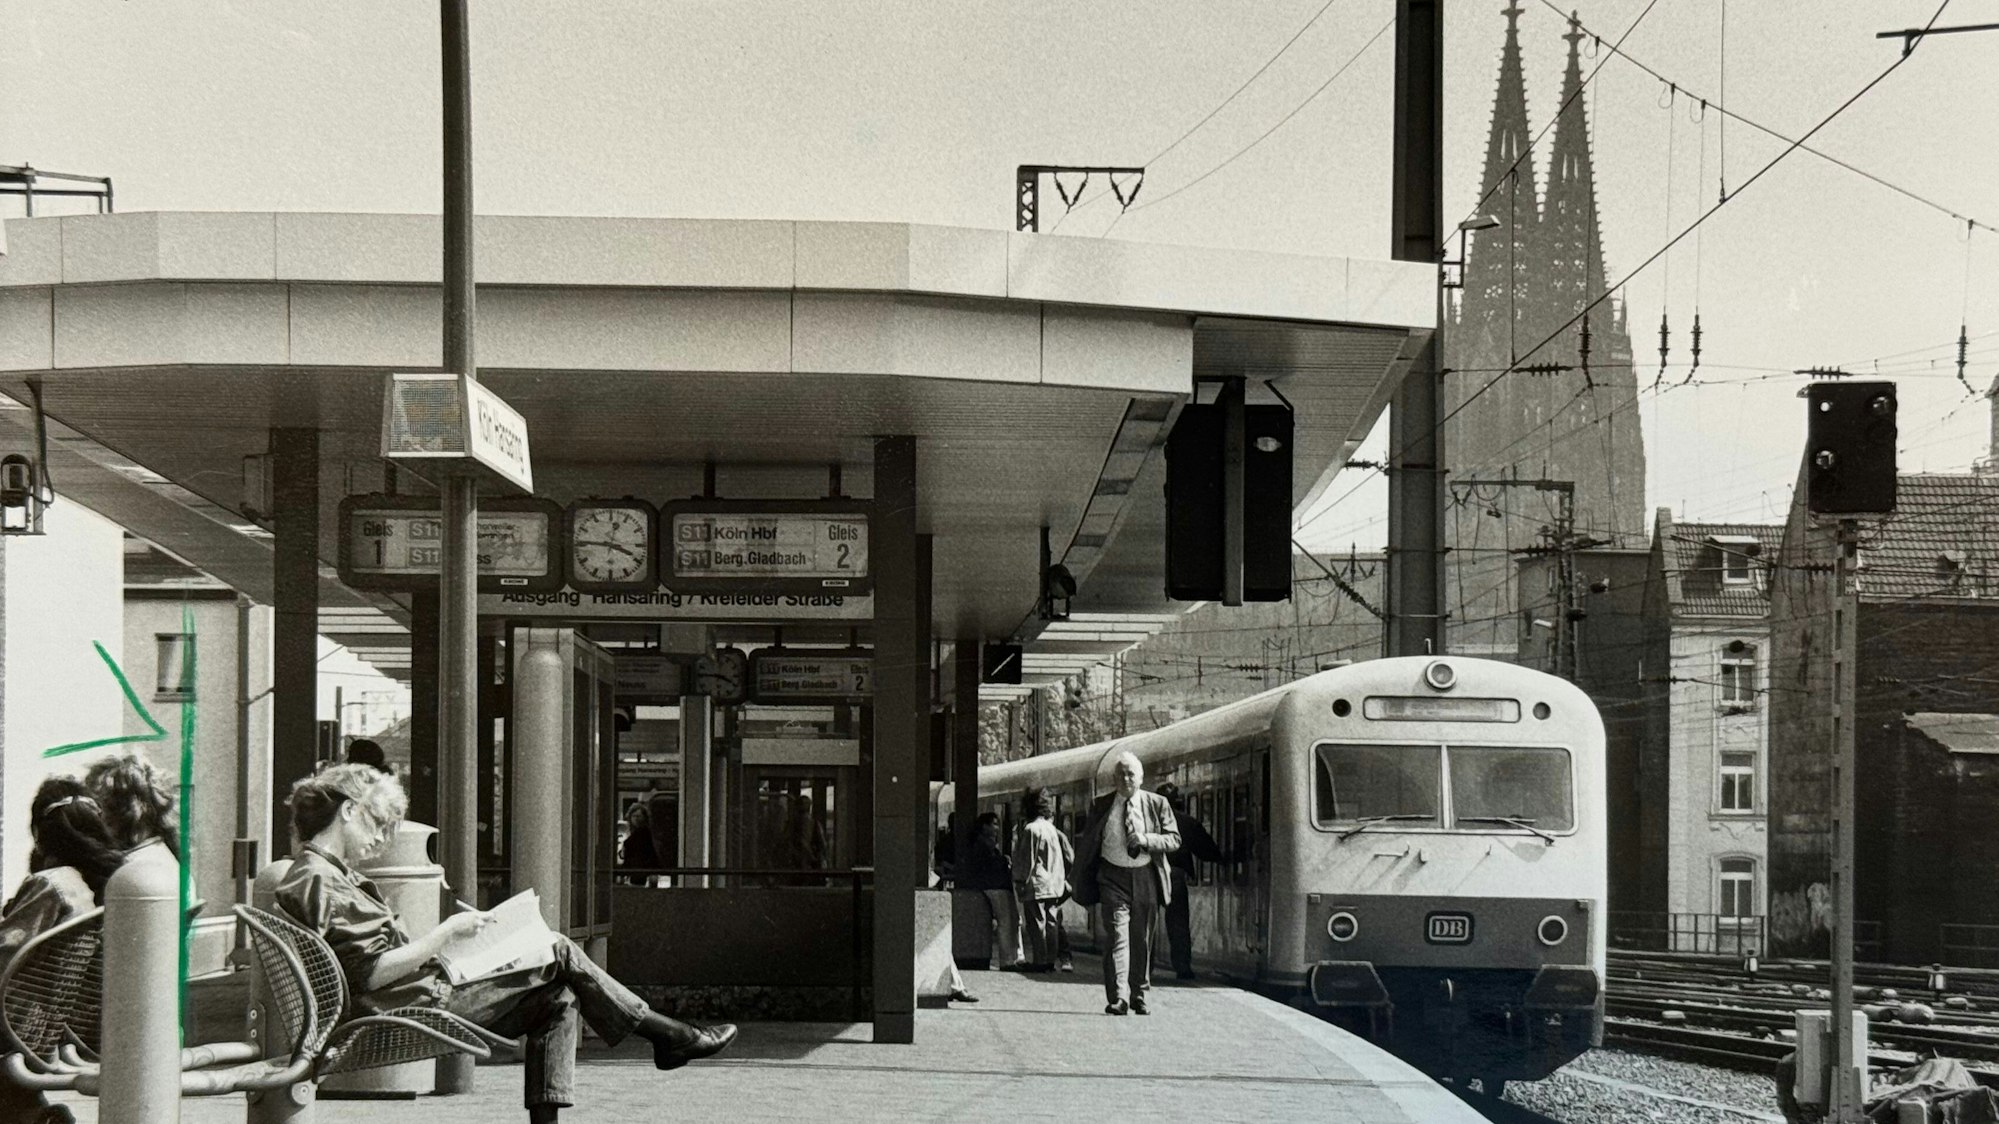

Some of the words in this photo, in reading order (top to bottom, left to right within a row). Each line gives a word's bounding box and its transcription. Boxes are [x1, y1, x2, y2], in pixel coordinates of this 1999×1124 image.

[363, 520, 394, 537] Gleis
[411, 522, 441, 537] S11
[680, 523, 710, 539] S11
[714, 525, 749, 540] Köln
[751, 526, 778, 540] Hbf
[828, 524, 859, 541] Gleis
[374, 539, 382, 565] 1
[411, 551, 441, 565] S11
[680, 552, 710, 566] S11
[714, 551, 807, 568] Berg.Gladbach
[836, 542, 851, 569] 2
[501, 592, 581, 607] Ausgang
[781, 663, 803, 674] Köln
[855, 675, 864, 691] 2
[1434, 920, 1464, 936] DB
